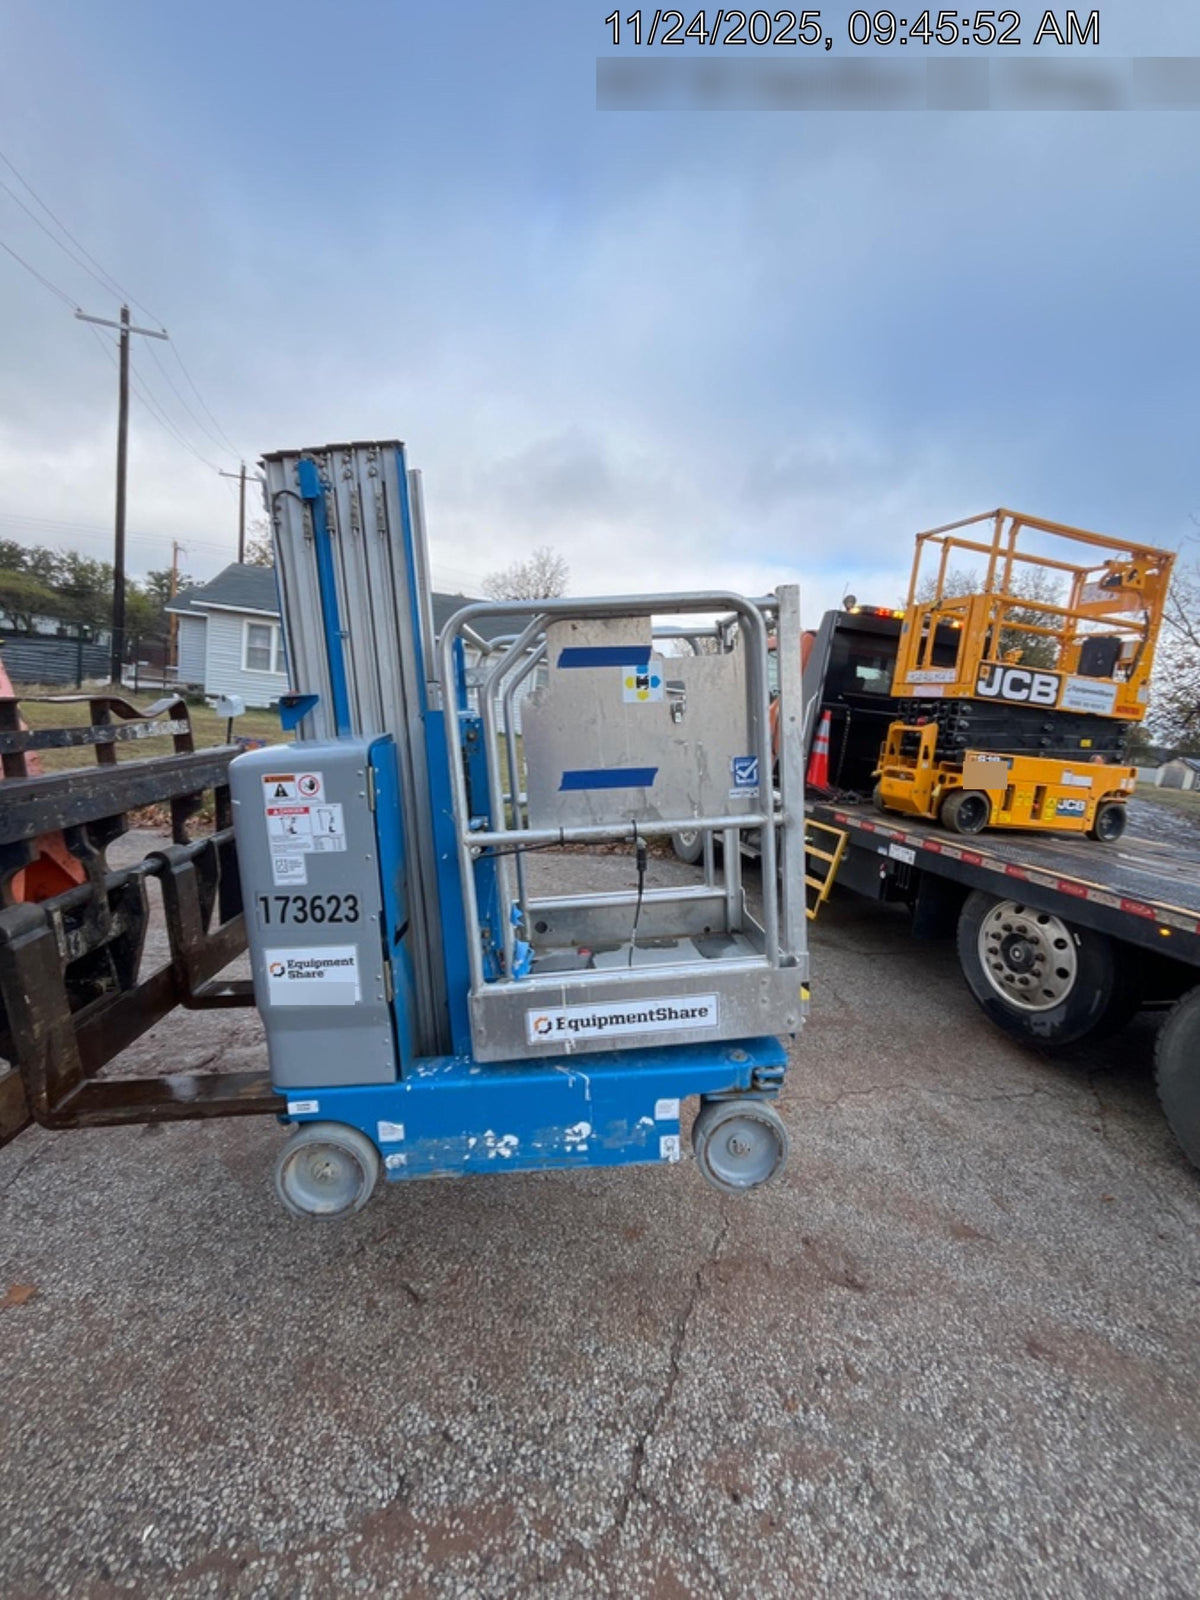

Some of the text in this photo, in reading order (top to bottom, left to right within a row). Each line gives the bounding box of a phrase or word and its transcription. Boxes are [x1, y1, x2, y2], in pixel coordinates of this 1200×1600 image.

[977, 668, 1058, 706] JCB
[1057, 799, 1086, 811] JCB
[259, 894, 360, 924] 173623
[287, 957, 355, 970] Equipment
[288, 970, 324, 979] Share
[556, 1006, 708, 1032] EquipmentShare
